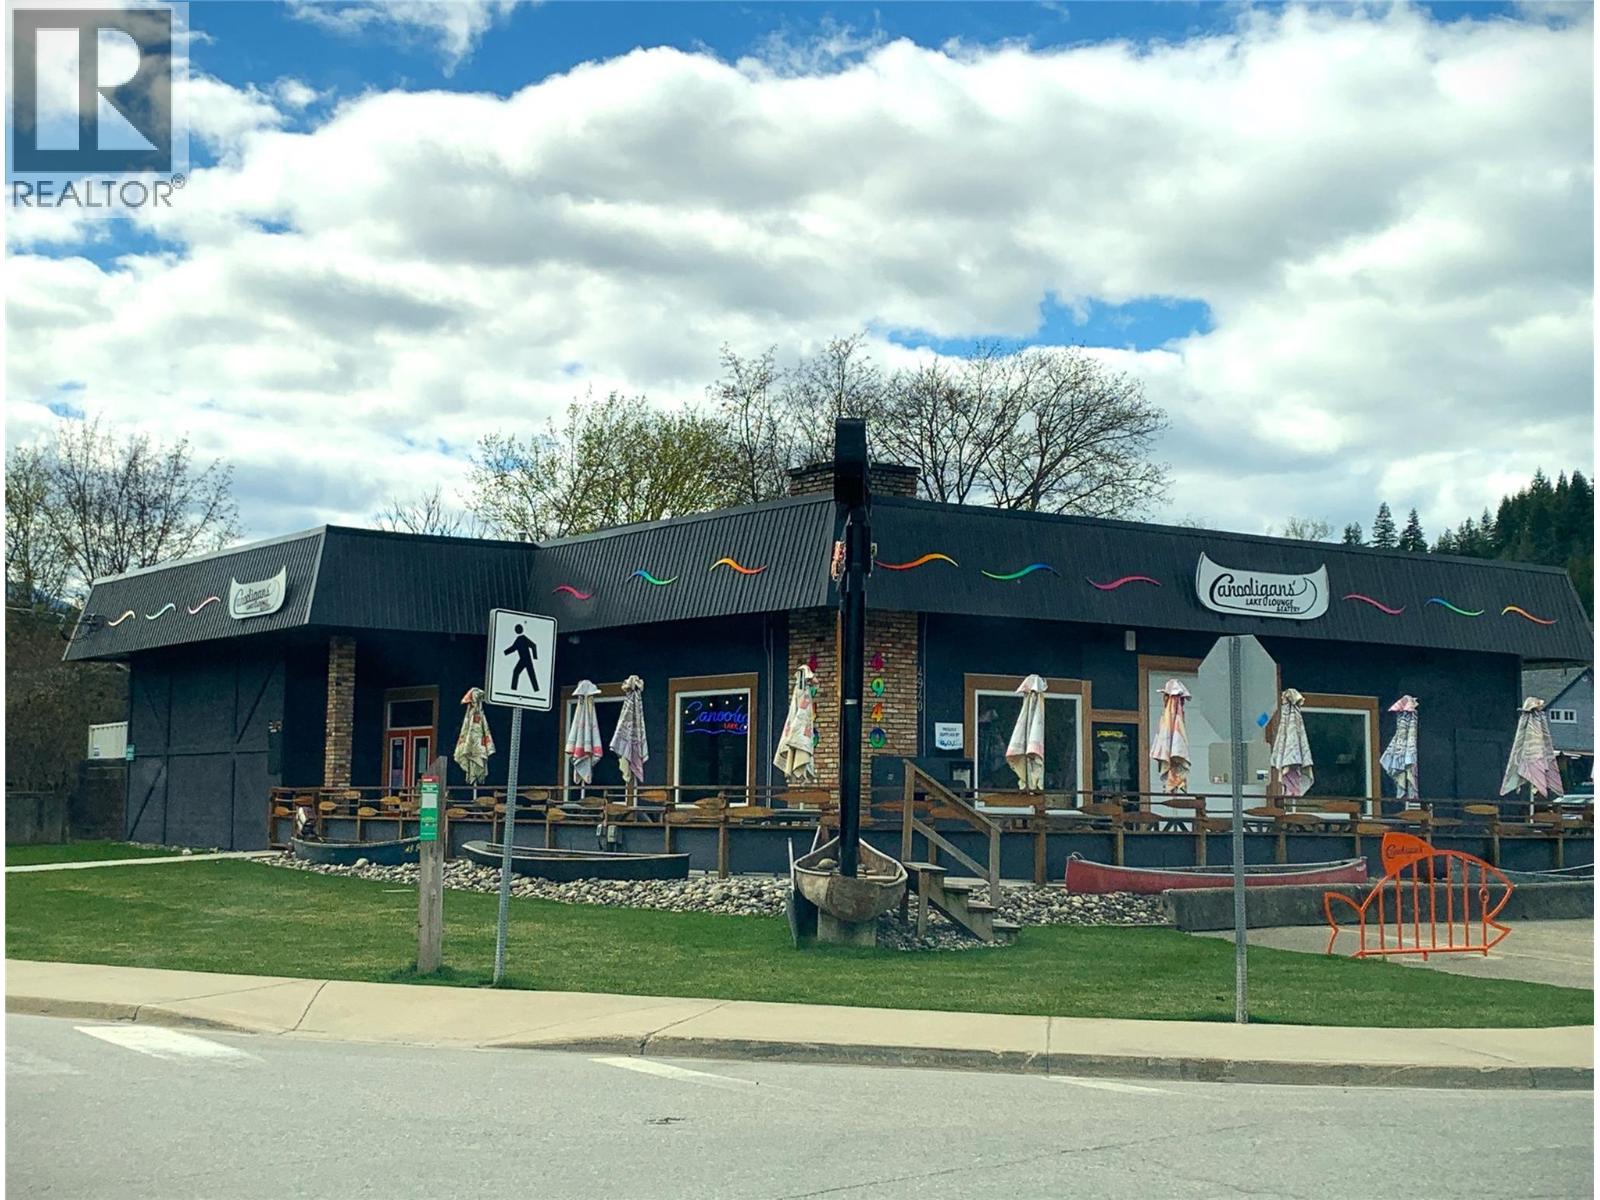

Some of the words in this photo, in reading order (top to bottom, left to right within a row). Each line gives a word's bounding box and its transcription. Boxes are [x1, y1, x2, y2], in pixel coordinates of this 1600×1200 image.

[1208, 573, 1297, 606] Canooligans'
[1245, 598, 1262, 606] LAKE
[1268, 598, 1295, 607] LOUNGE
